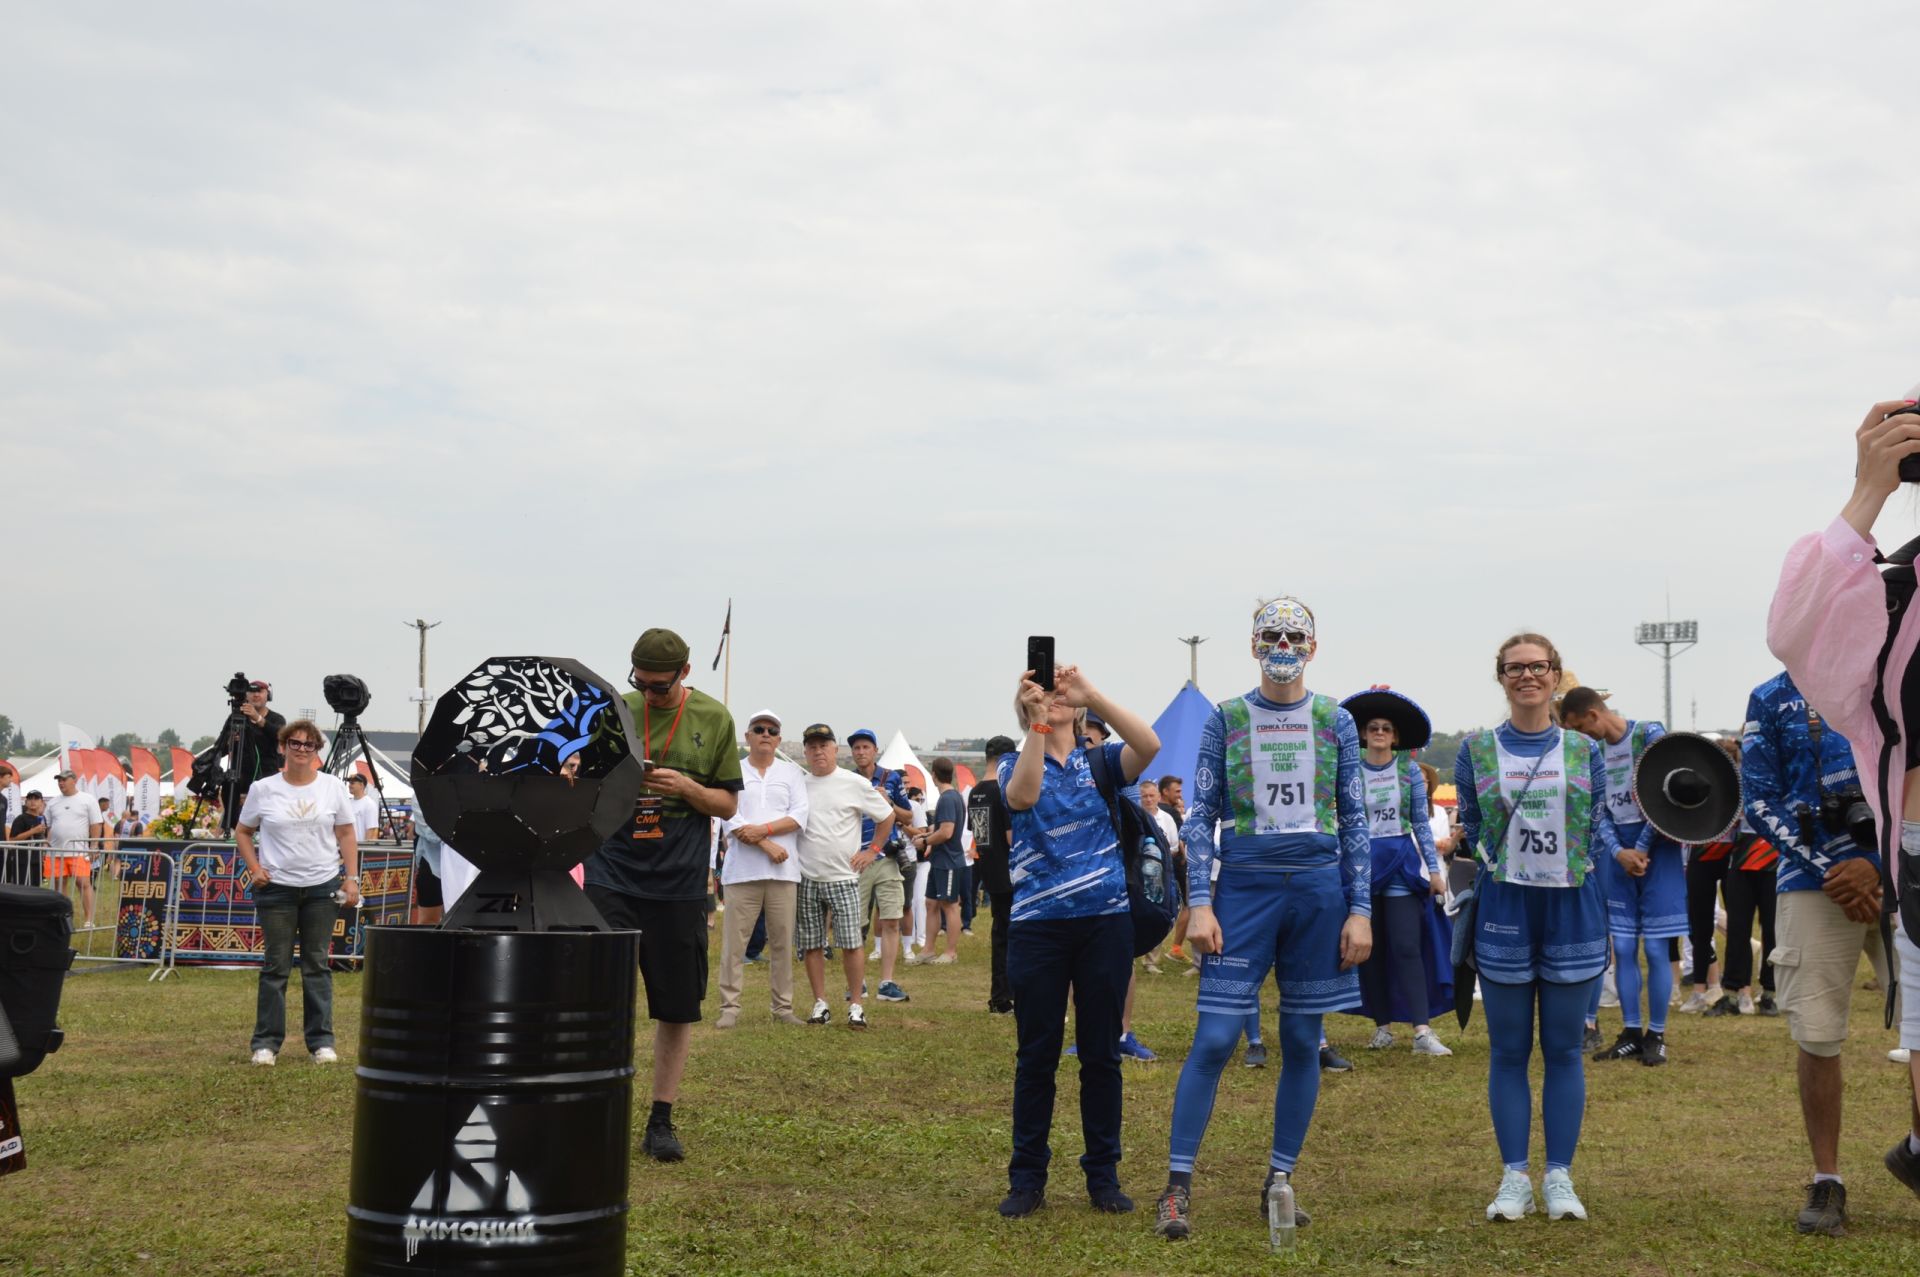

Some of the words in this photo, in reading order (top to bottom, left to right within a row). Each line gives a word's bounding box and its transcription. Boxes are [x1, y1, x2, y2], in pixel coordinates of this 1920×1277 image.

[1260, 740, 1307, 752] МАССОВЫЙ
[1272, 752, 1296, 761] СТАРТ
[1270, 763, 1299, 772] 10КМ+
[1266, 782, 1305, 806] 751
[1611, 790, 1632, 808] 754
[1522, 800, 1546, 810] СТАРТ
[635, 815, 660, 824] СМИ
[1374, 807, 1396, 823] 752
[1521, 810, 1551, 819] 10КМ+
[1752, 799, 1832, 871] KAMAZ
[1519, 828, 1558, 855] 753
